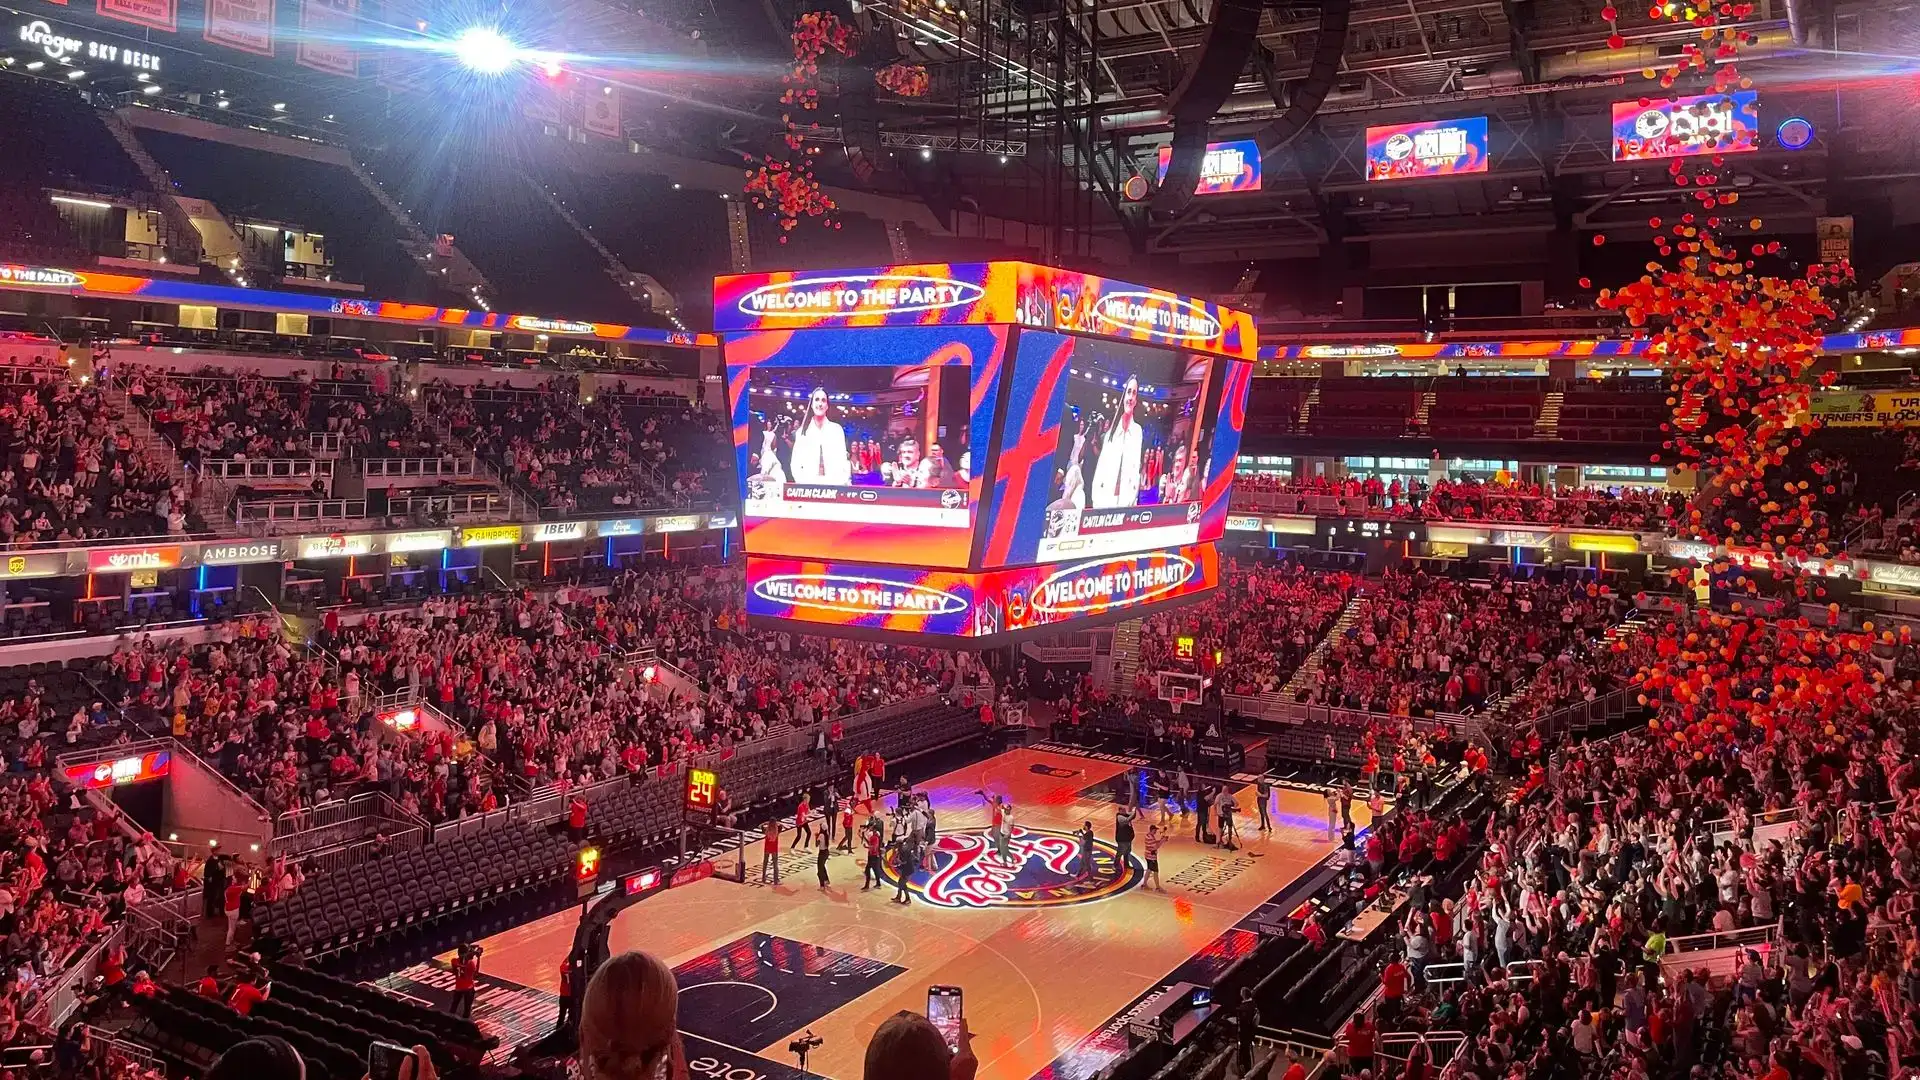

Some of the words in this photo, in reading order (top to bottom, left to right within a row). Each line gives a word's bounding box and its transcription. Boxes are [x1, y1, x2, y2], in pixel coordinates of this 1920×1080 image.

[20, 21, 82, 58] Kroger
[89, 41, 118, 62] SKY
[123, 49, 161, 71] DECK
[1423, 156, 1458, 167] PARTY
[0, 268, 12, 279] TO
[14, 270, 36, 281] THE
[37, 272, 76, 284] PARTY
[751, 291, 831, 310] WELCOME
[833, 290, 857, 306] TO
[861, 288, 895, 305] THE
[899, 286, 963, 304] PARTY
[518, 317, 549, 330] WELCOME
[549, 320, 560, 330] TO
[560, 321, 571, 331] THE
[572, 322, 592, 333] PARTY
[1105, 300, 1157, 324] WELCOME
[1159, 310, 1170, 326] TO
[1172, 312, 1189, 330] THE
[1189, 314, 1215, 336] PARTY
[1310, 347, 1345, 356] WELCOME
[1346, 347, 1354, 355] TO
[1356, 347, 1370, 355] THE
[1371, 346, 1395, 355] PARTY
[1810, 412, 1873, 423] TURNER'S
[786, 487, 812, 498] CAITLIN
[812, 488, 837, 499] CLARK
[1083, 514, 1106, 528] CAITLIN
[1105, 513, 1126, 526] CLARK
[476, 529, 519, 541] GAINBRIDGE
[544, 523, 576, 535] IBEW
[128, 551, 160, 567] mhs
[203, 544, 278, 560] AMBROSE
[1045, 575, 1113, 606] WELCOME
[1115, 572, 1131, 592] TO
[1132, 569, 1154, 590] THE
[1154, 563, 1186, 585] PARTY
[766, 581, 835, 602] WELCOME
[837, 588, 859, 604] TO
[861, 589, 892, 607] THE
[894, 594, 950, 611] PARTY
[1177, 644, 1193, 656] 24
[1029, 743, 1090, 757] INDIANA
[1090, 752, 1152, 766] PACERS
[693, 770, 715, 785] 10:00
[690, 781, 712, 804] 24
[1187, 857, 1257, 896] GAINBRIDGE
